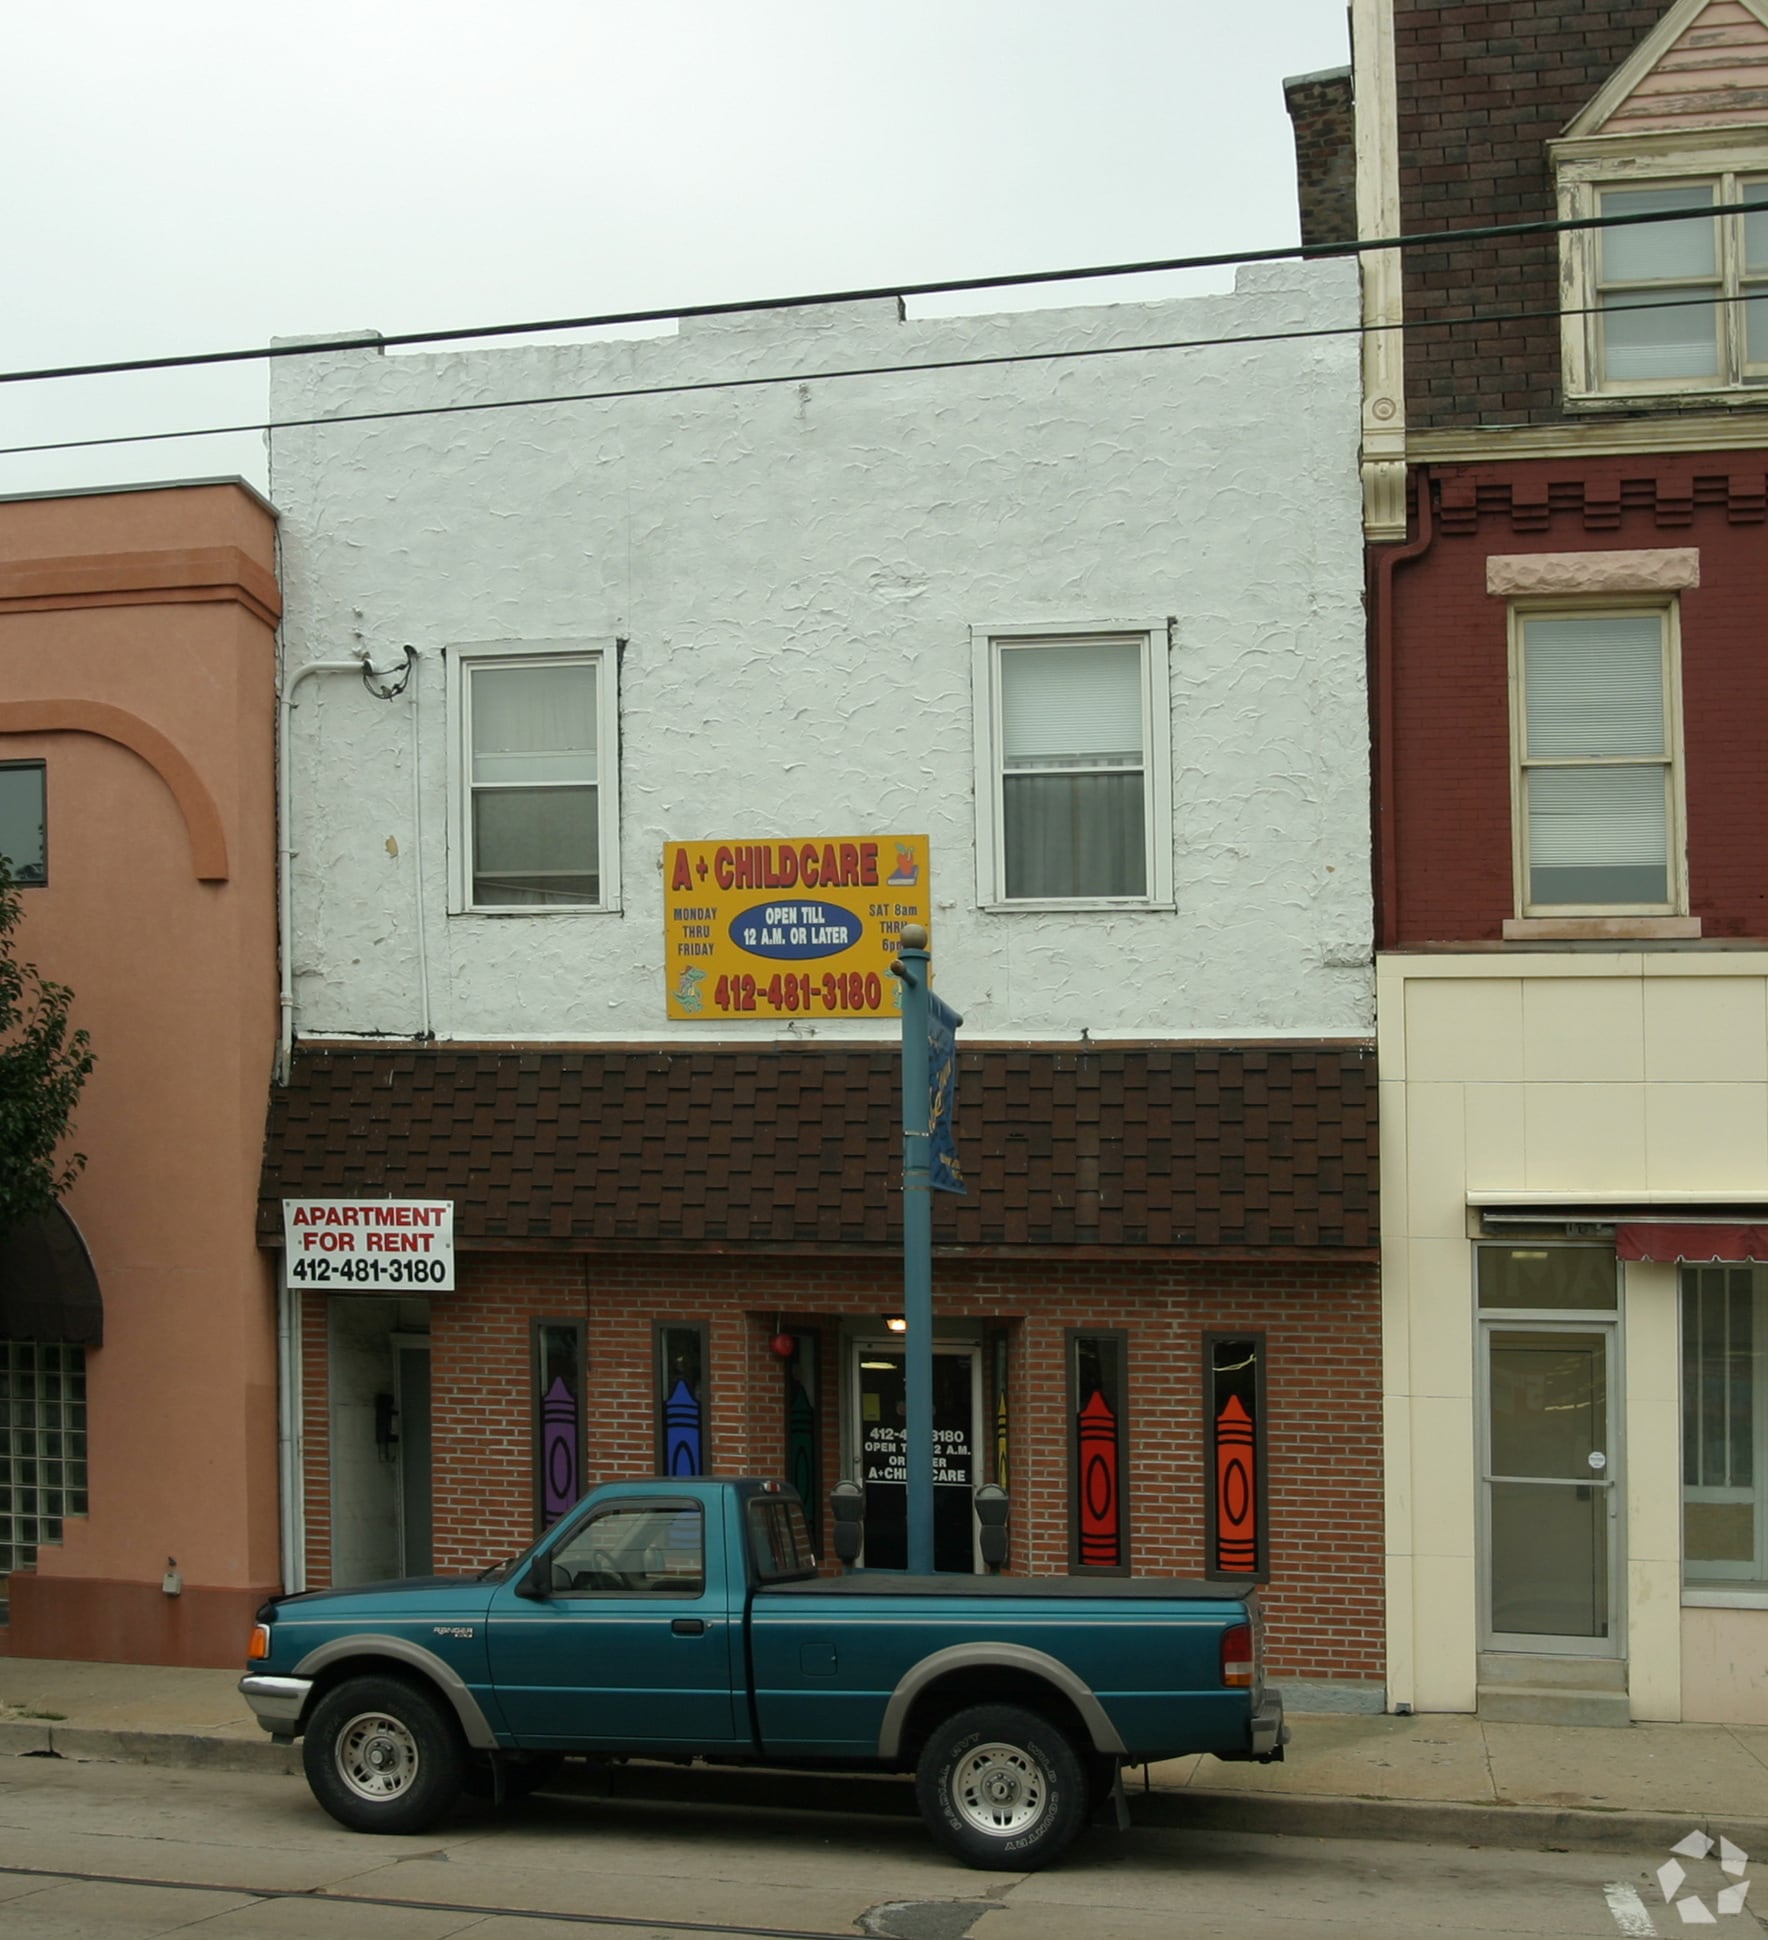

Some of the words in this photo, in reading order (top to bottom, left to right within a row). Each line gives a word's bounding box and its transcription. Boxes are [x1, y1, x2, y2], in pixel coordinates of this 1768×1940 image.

[673, 907, 717, 921] MONDAY
[765, 907, 798, 925] OPEN
[801, 906, 825, 924] TILL
[869, 904, 889, 917] SAT
[894, 903, 917, 916] 8am
[683, 925, 710, 939] THRU
[743, 929, 757, 946] 12
[761, 928, 786, 945] A.M.
[790, 927, 808, 944] OR
[811, 926, 848, 944] LATER
[678, 943, 715, 957] FRIDAY
[714, 971, 882, 1011] 412-481-3180
[293, 1207, 446, 1226] APARTMENT
[303, 1232, 355, 1252] FOR
[367, 1233, 434, 1252] RENT
[293, 1258, 446, 1283] 412-481-3180
[865, 1442, 896, 1452] OPEN
[946, 1445, 971, 1455] A.M.
[889, 1456, 905, 1466] OR
